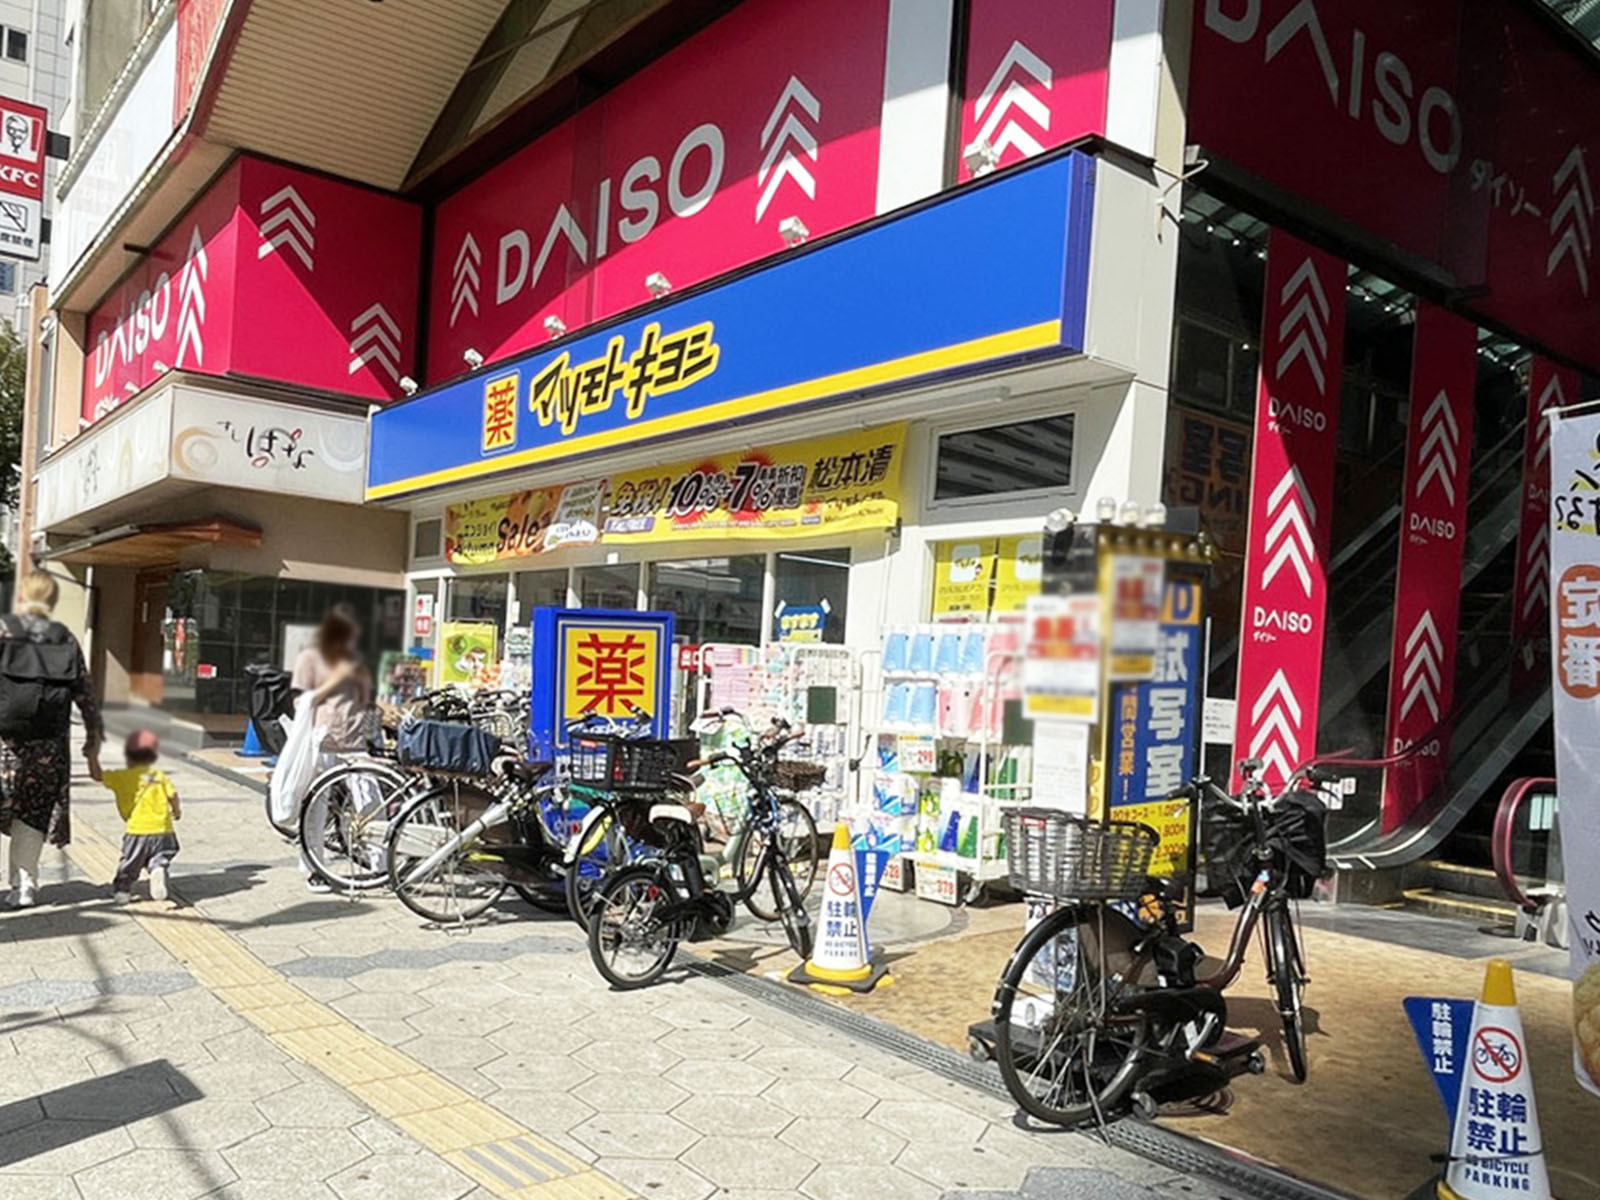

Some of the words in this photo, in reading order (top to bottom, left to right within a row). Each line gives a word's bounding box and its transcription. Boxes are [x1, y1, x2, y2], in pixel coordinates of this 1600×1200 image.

[496, 123, 725, 305] DAISO
[94, 272, 170, 389] DAISO
[483, 380, 516, 447] 薬
[530, 323, 718, 434] マツモトキヨシ
[1267, 397, 1326, 432] DAISO
[807, 446, 895, 491] 松本清
[497, 513, 540, 554] Sale
[1409, 512, 1455, 539] DAISO
[1253, 605, 1312, 634] DAISO
[575, 632, 649, 717] 薬
[826, 920, 857, 938] 禁止
[1431, 1002, 1454, 1074] 駐輪禁止
[1467, 1087, 1527, 1123] 駐輪
[1467, 1121, 1529, 1156] 禁止
[1464, 1168, 1530, 1191] PARKING
[1481, 1157, 1530, 1175] BICYCLE
